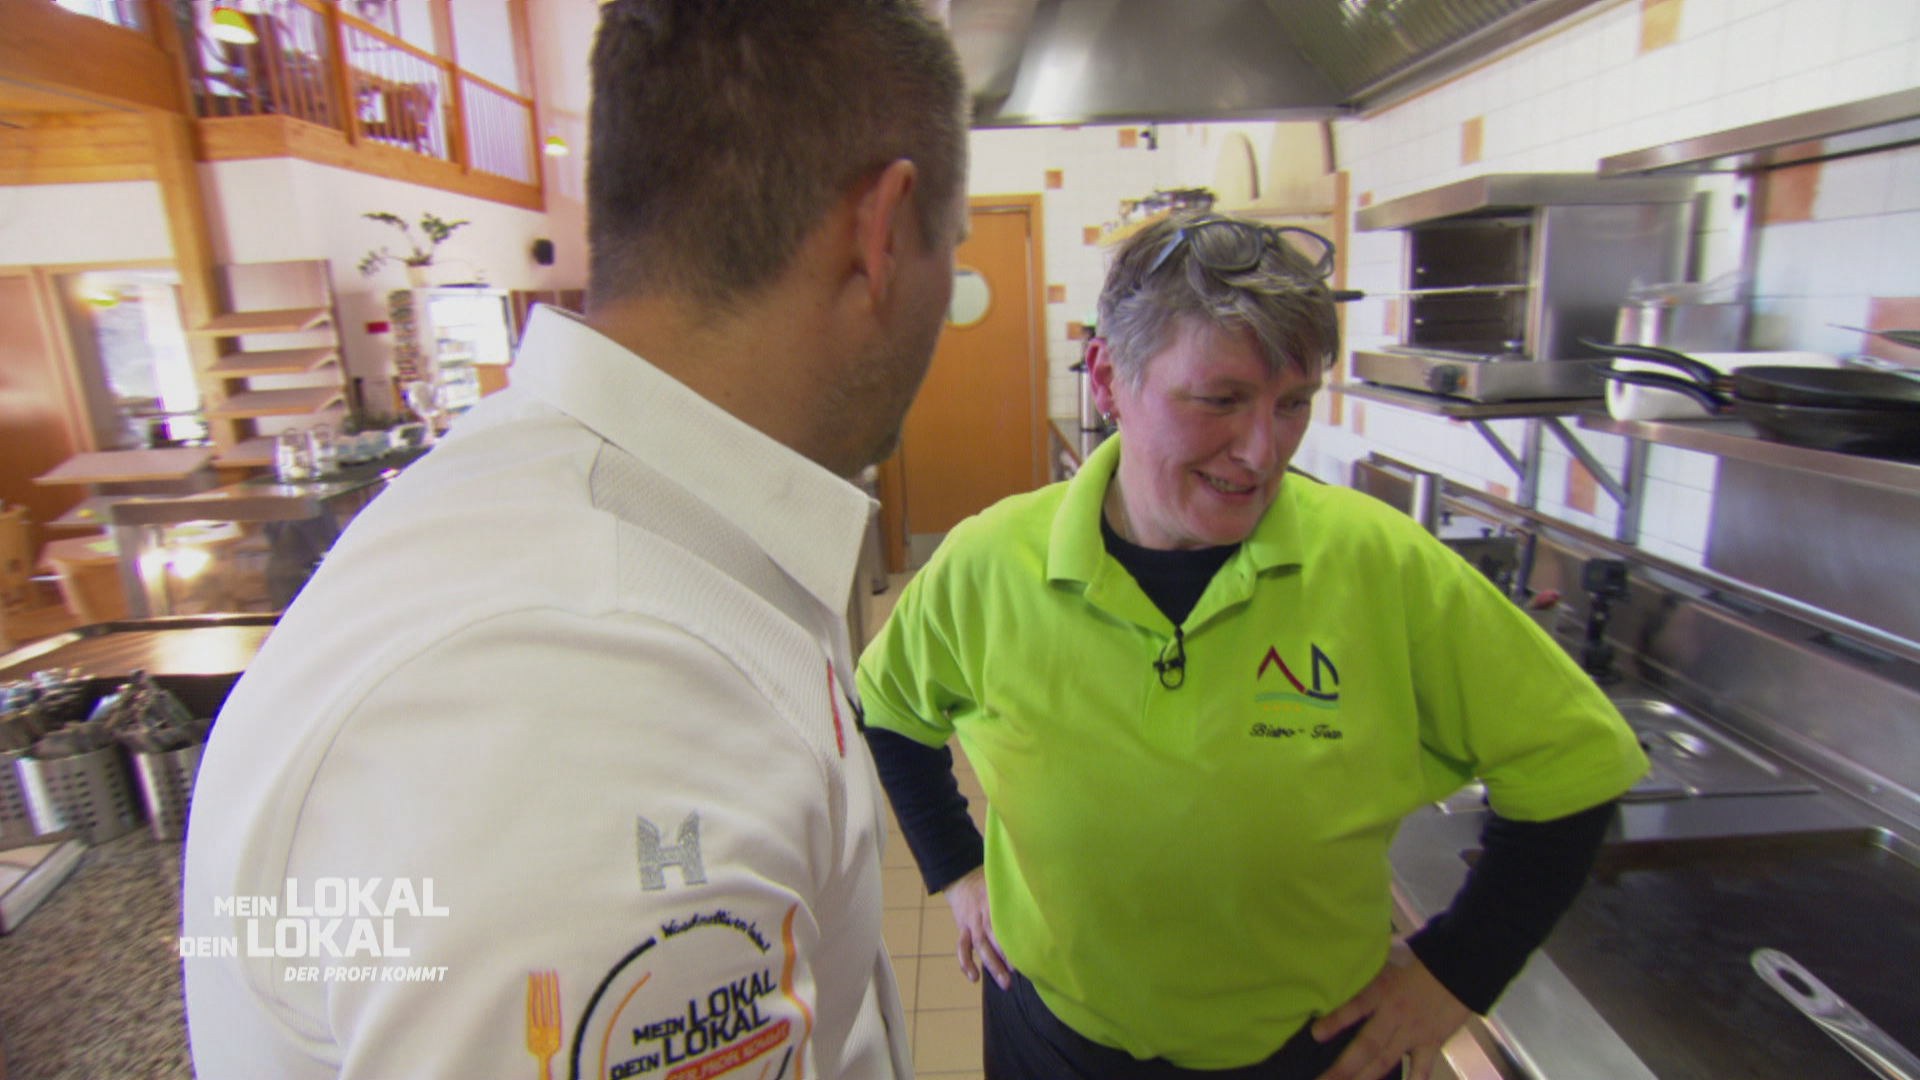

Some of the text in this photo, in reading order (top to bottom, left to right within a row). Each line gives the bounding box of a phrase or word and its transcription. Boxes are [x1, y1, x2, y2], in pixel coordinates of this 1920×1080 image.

[610, 1001, 772, 1080] DEIN LOKAL
[632, 969, 778, 1046] MEIN LOKAL
